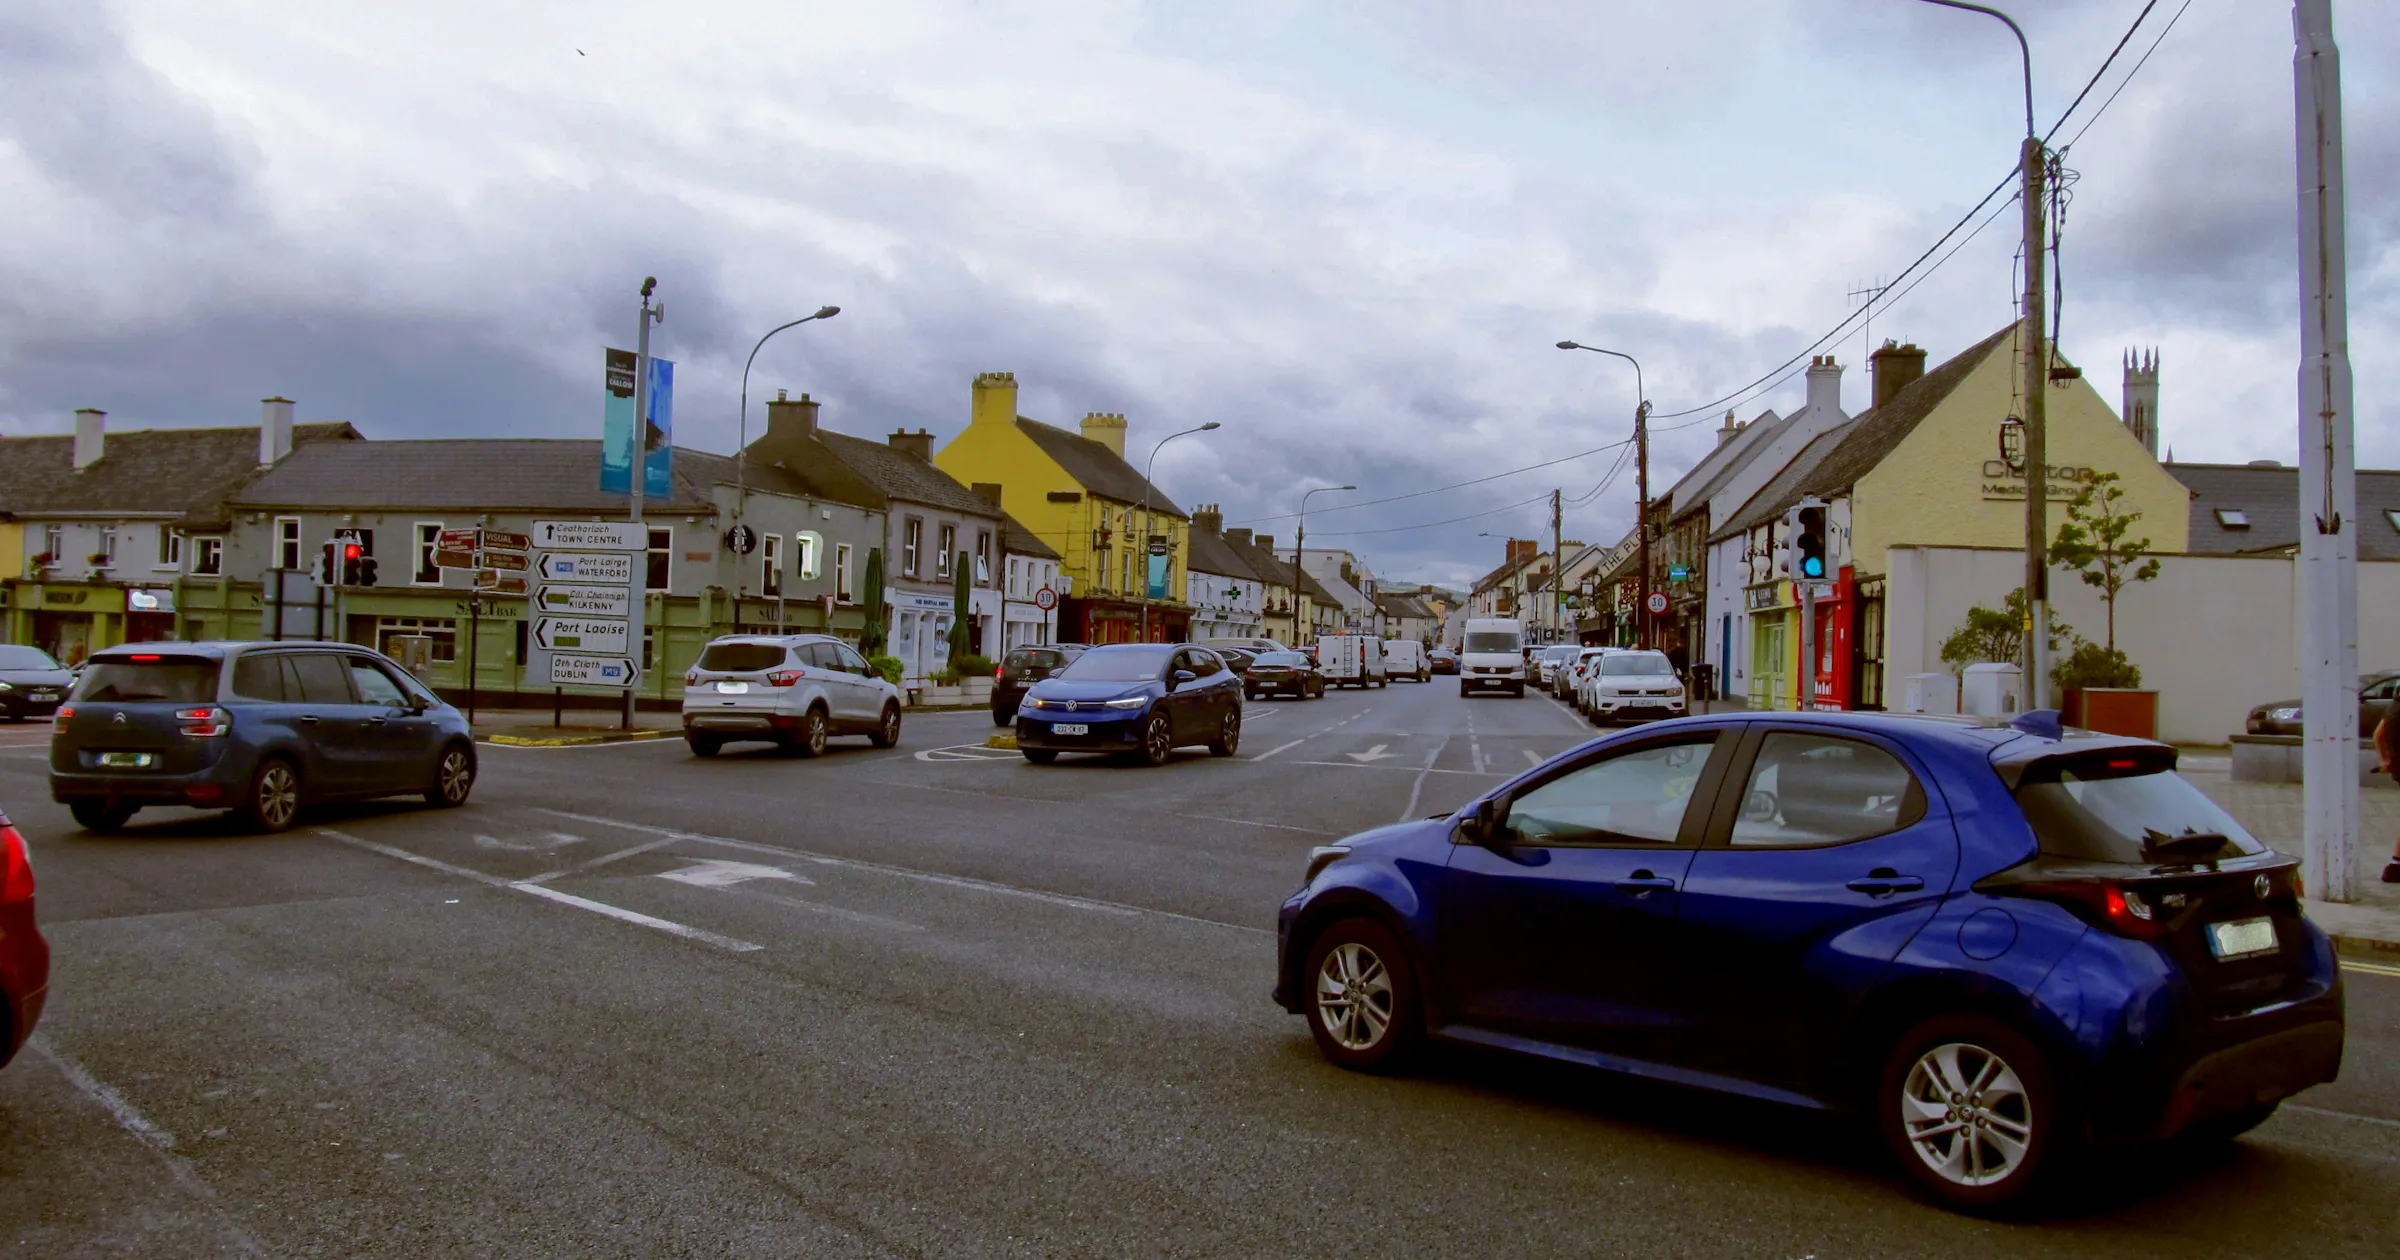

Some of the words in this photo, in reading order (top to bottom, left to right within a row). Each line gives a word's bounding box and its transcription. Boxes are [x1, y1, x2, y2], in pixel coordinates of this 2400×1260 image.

[486, 532, 512, 543] VISUAL
[557, 535, 582, 543] TOWN
[588, 536, 623, 545] CENTRE
[579, 558, 597, 566] Port
[601, 558, 627, 568] Lairge
[1602, 552, 1624, 571] THE
[578, 568, 628, 578] WATERFORD
[1041, 593, 1051, 603] 30
[1652, 598, 1663, 607] 30
[569, 601, 613, 610] KILKENNY
[497, 607, 516, 616] BAR
[758, 607, 780, 622] SAL
[554, 622, 579, 633] Port
[586, 623, 625, 634] Laoise
[574, 659, 600, 669] Cliath
[554, 670, 587, 679] DUBLIN
